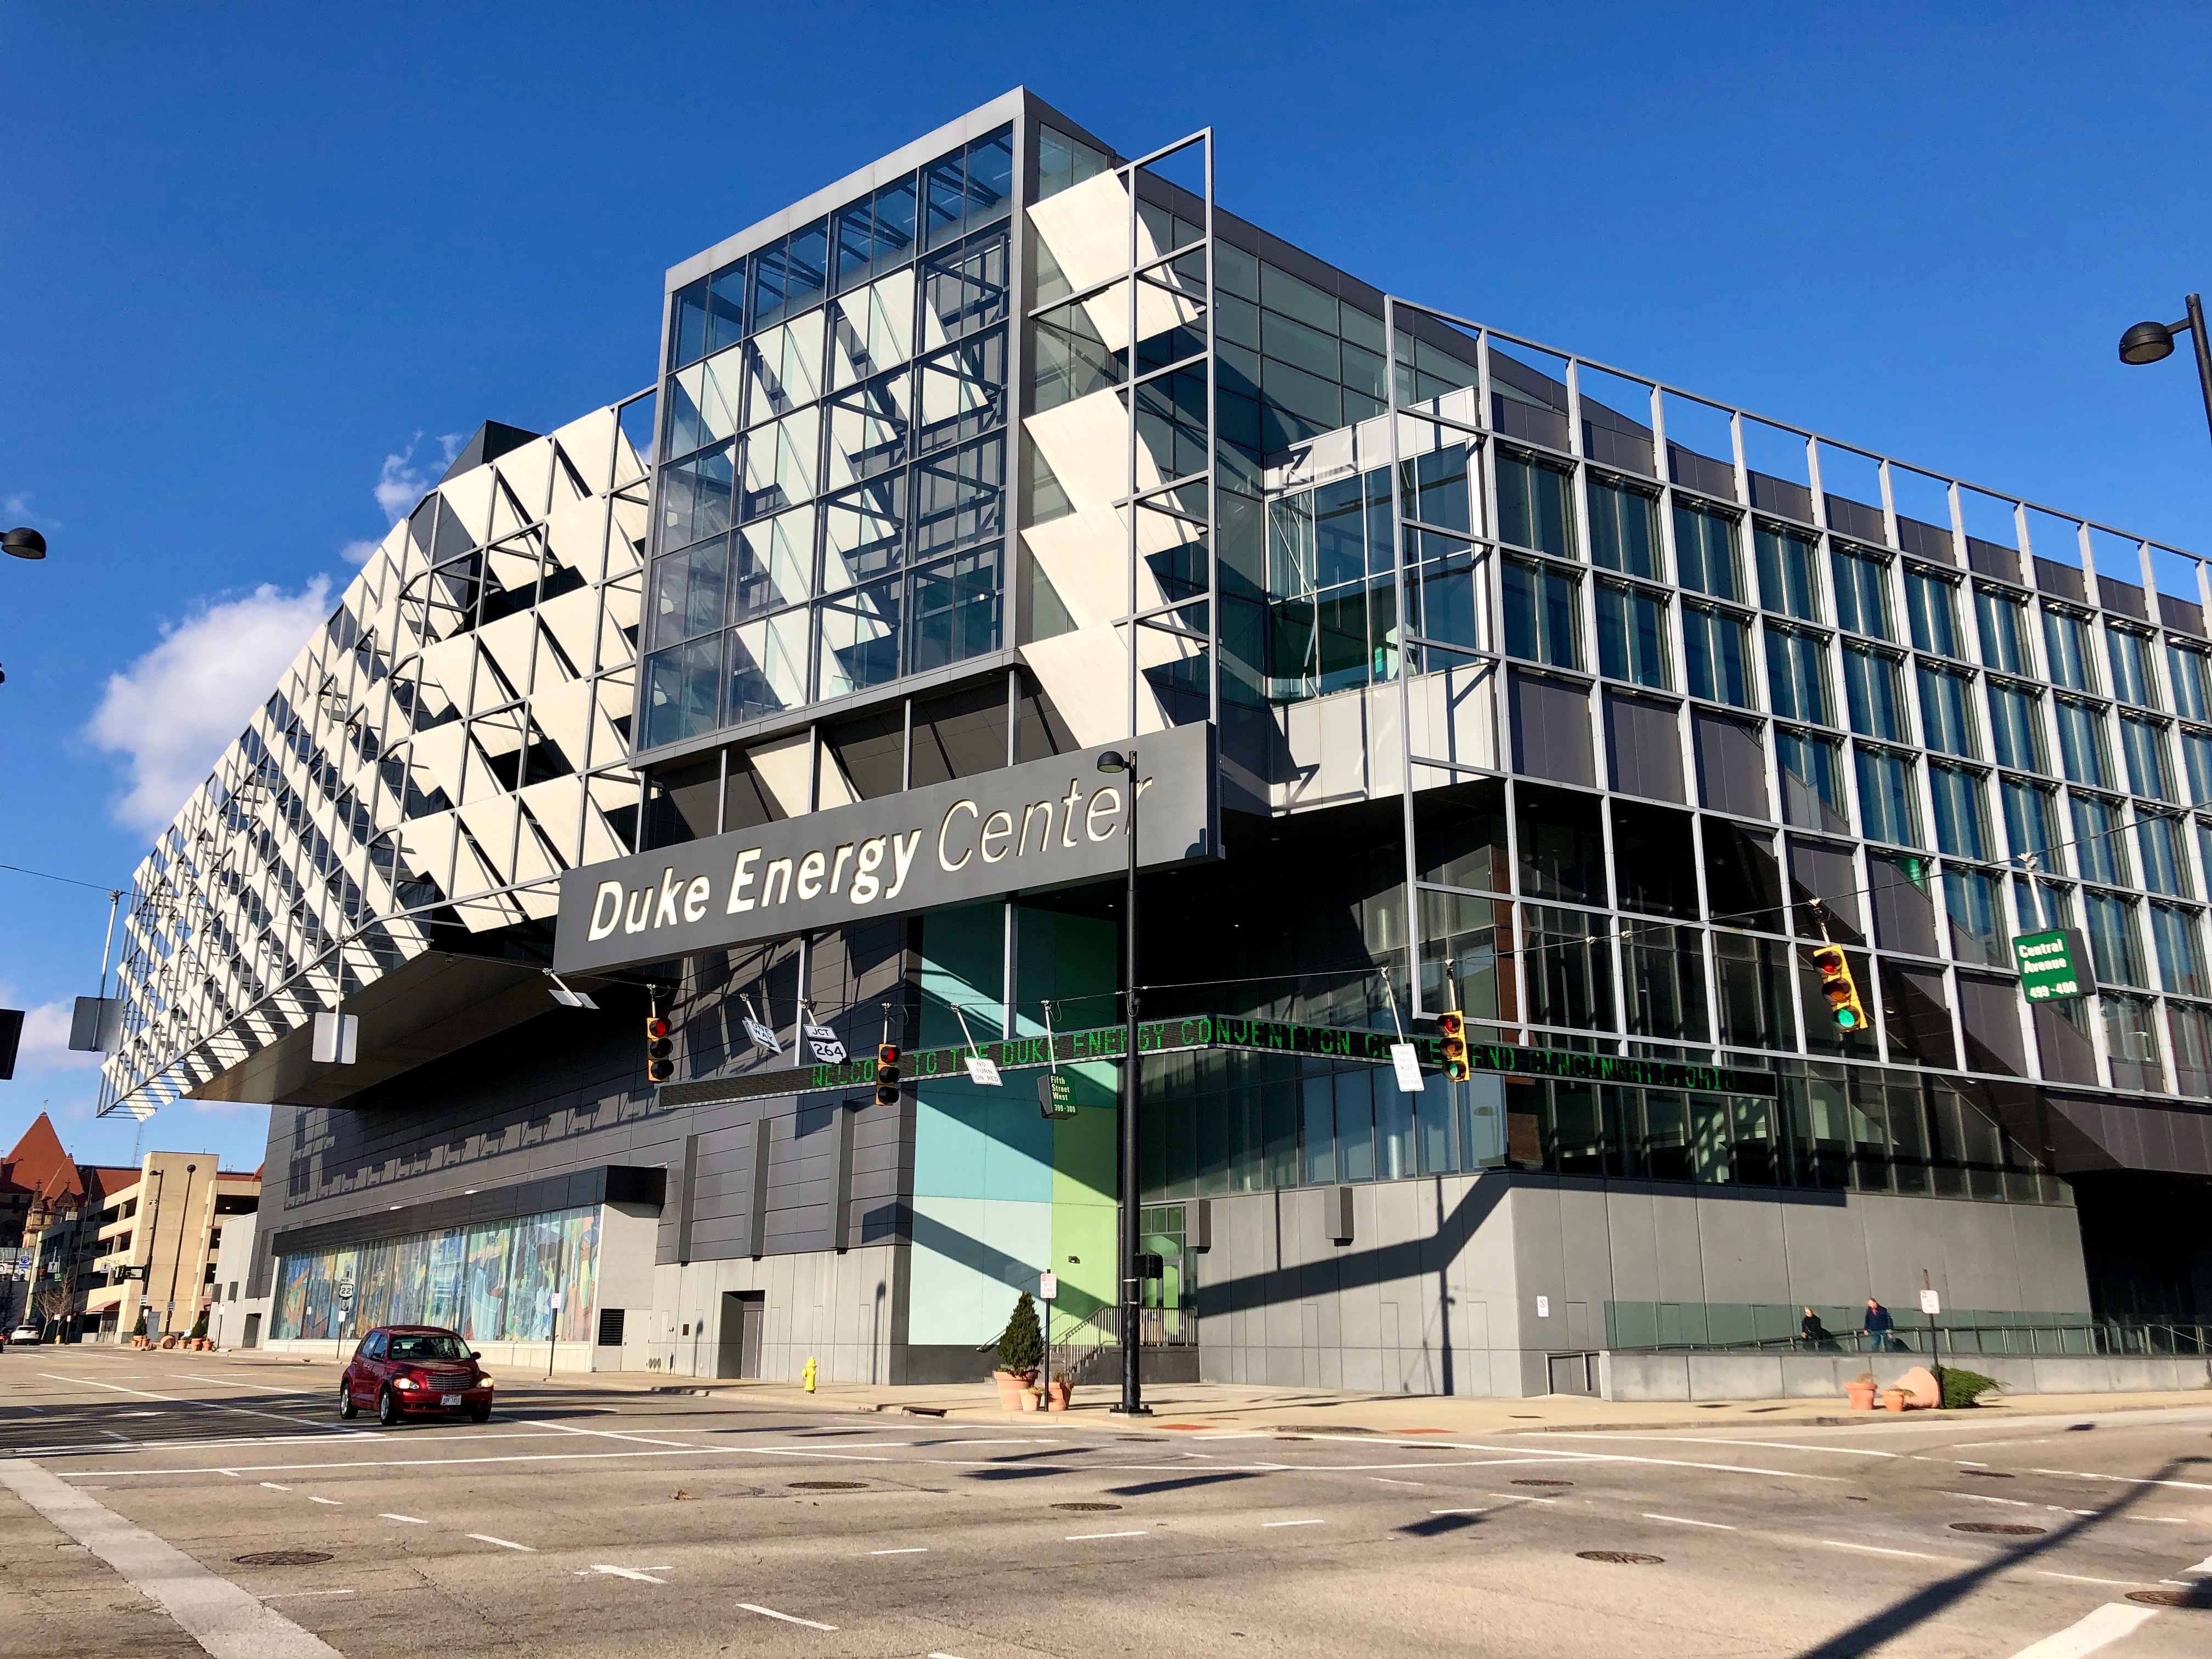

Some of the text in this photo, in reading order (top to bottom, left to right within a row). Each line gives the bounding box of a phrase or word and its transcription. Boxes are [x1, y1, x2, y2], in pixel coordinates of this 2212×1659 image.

[588, 777, 1153, 942] Duke Energy Center
[2018, 938, 2064, 958] Central
[2024, 957, 2067, 974] Avenue
[751, 1022, 771, 1035] ONE
[753, 1028, 772, 1041] WAY
[812, 1028, 830, 1036] JCT
[812, 1059, 874, 1087] WELCO
[913, 1051, 937, 1076] TO
[1002, 1036, 1059, 1065] DUKE
[1181, 1018, 1350, 1055] CONVENTION
[1364, 1032, 1442, 1064] CETE
[813, 1043, 844, 1058] 264
[1050, 1075, 1065, 1084] Fifth
[1051, 1084, 1070, 1093] Street
[1052, 1092, 1068, 1101] West
